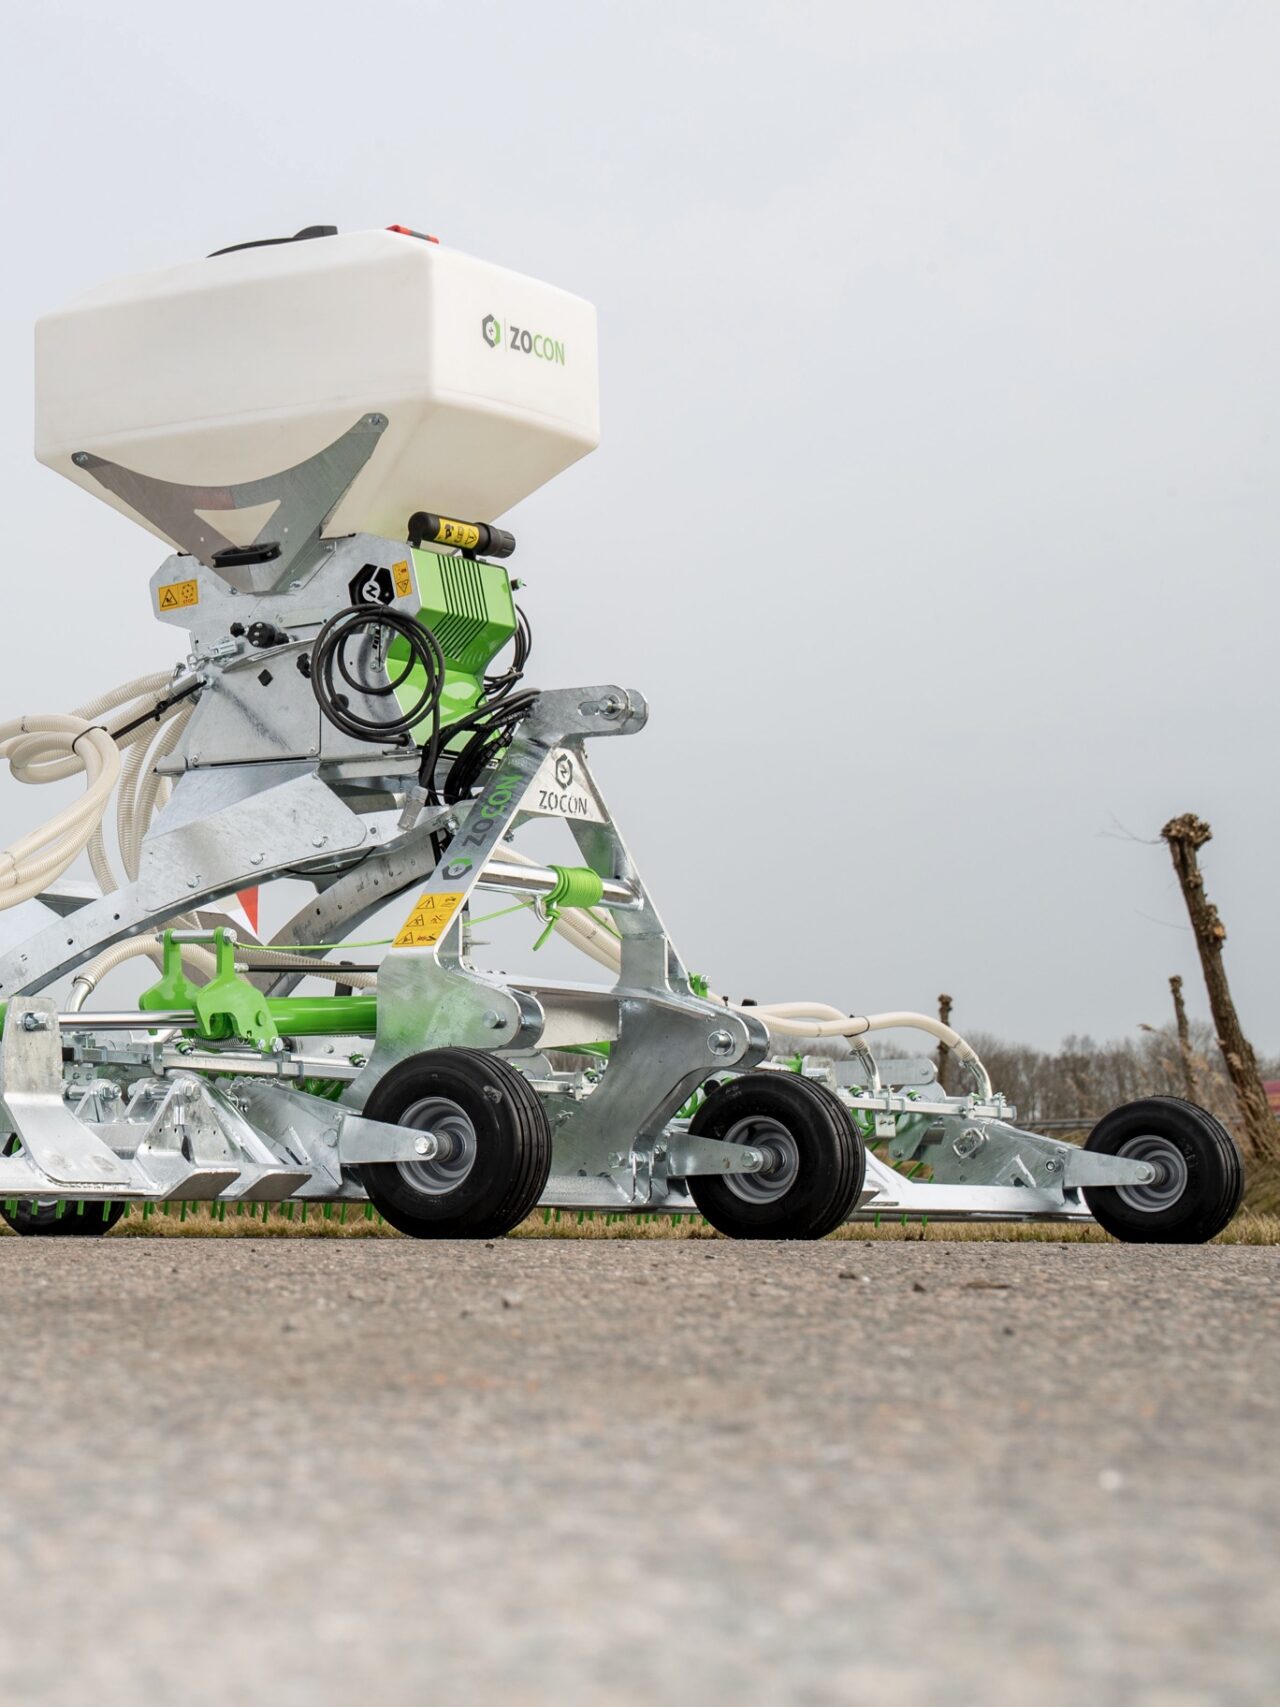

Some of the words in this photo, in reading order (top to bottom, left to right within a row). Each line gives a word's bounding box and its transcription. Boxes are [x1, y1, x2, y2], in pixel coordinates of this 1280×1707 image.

[510, 325, 566, 366] ZOCON
[462, 774, 523, 847] ZOCON
[539, 790, 587, 815] ZOCON
